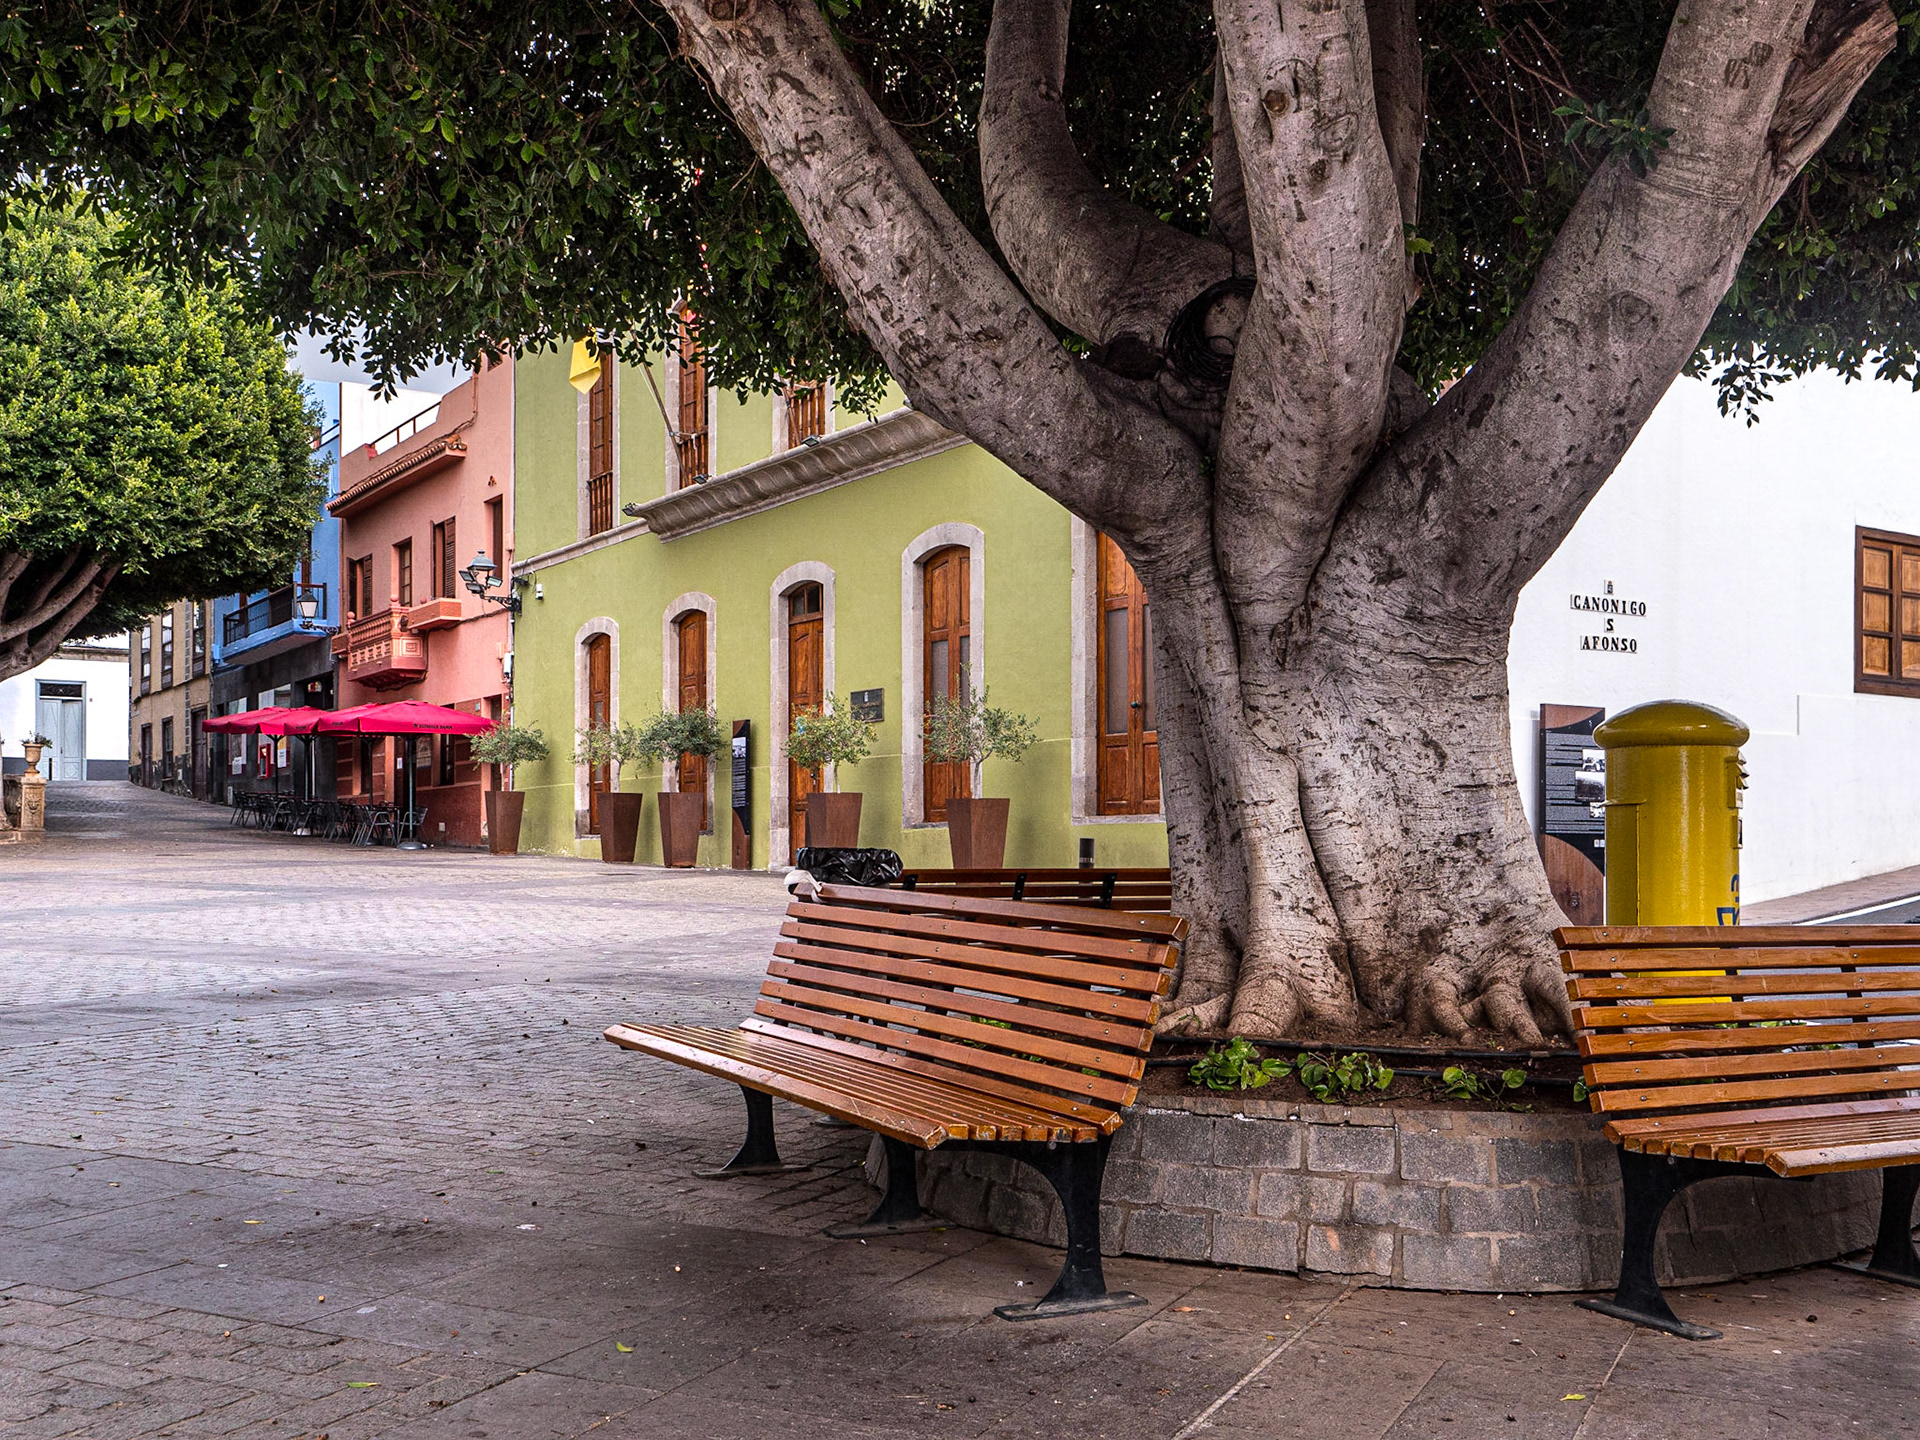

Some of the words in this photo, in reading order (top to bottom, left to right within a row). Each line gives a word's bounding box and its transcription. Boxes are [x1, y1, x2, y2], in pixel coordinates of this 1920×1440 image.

[1574, 595, 1646, 616] CANONIGO
[1606, 618, 1614, 632] S
[1582, 635, 1637, 653] AFONSO
